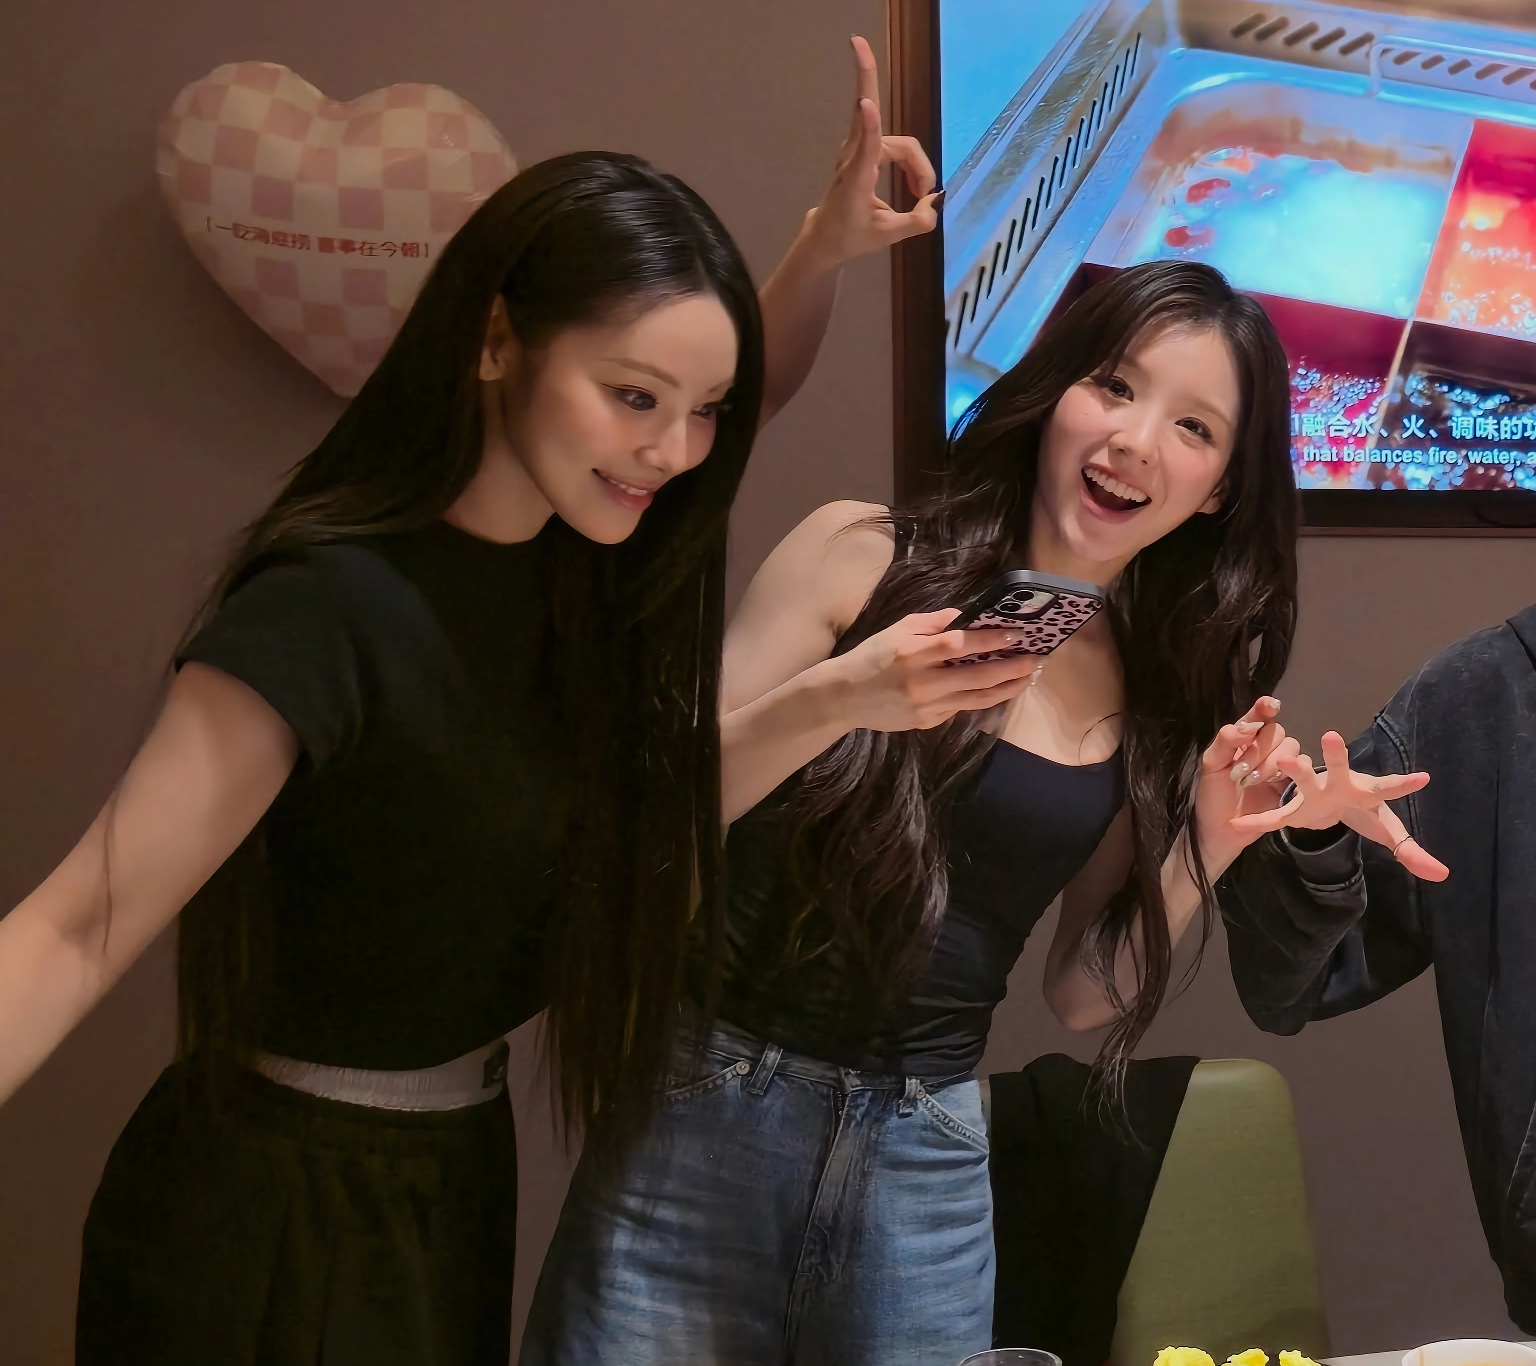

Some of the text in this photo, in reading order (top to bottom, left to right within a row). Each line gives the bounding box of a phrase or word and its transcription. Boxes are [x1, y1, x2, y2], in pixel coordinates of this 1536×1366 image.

[1303, 446, 1338, 463] that
[1343, 447, 1423, 464] balances
[1428, 448, 1462, 467] fire,
[1467, 450, 1521, 467] water,
